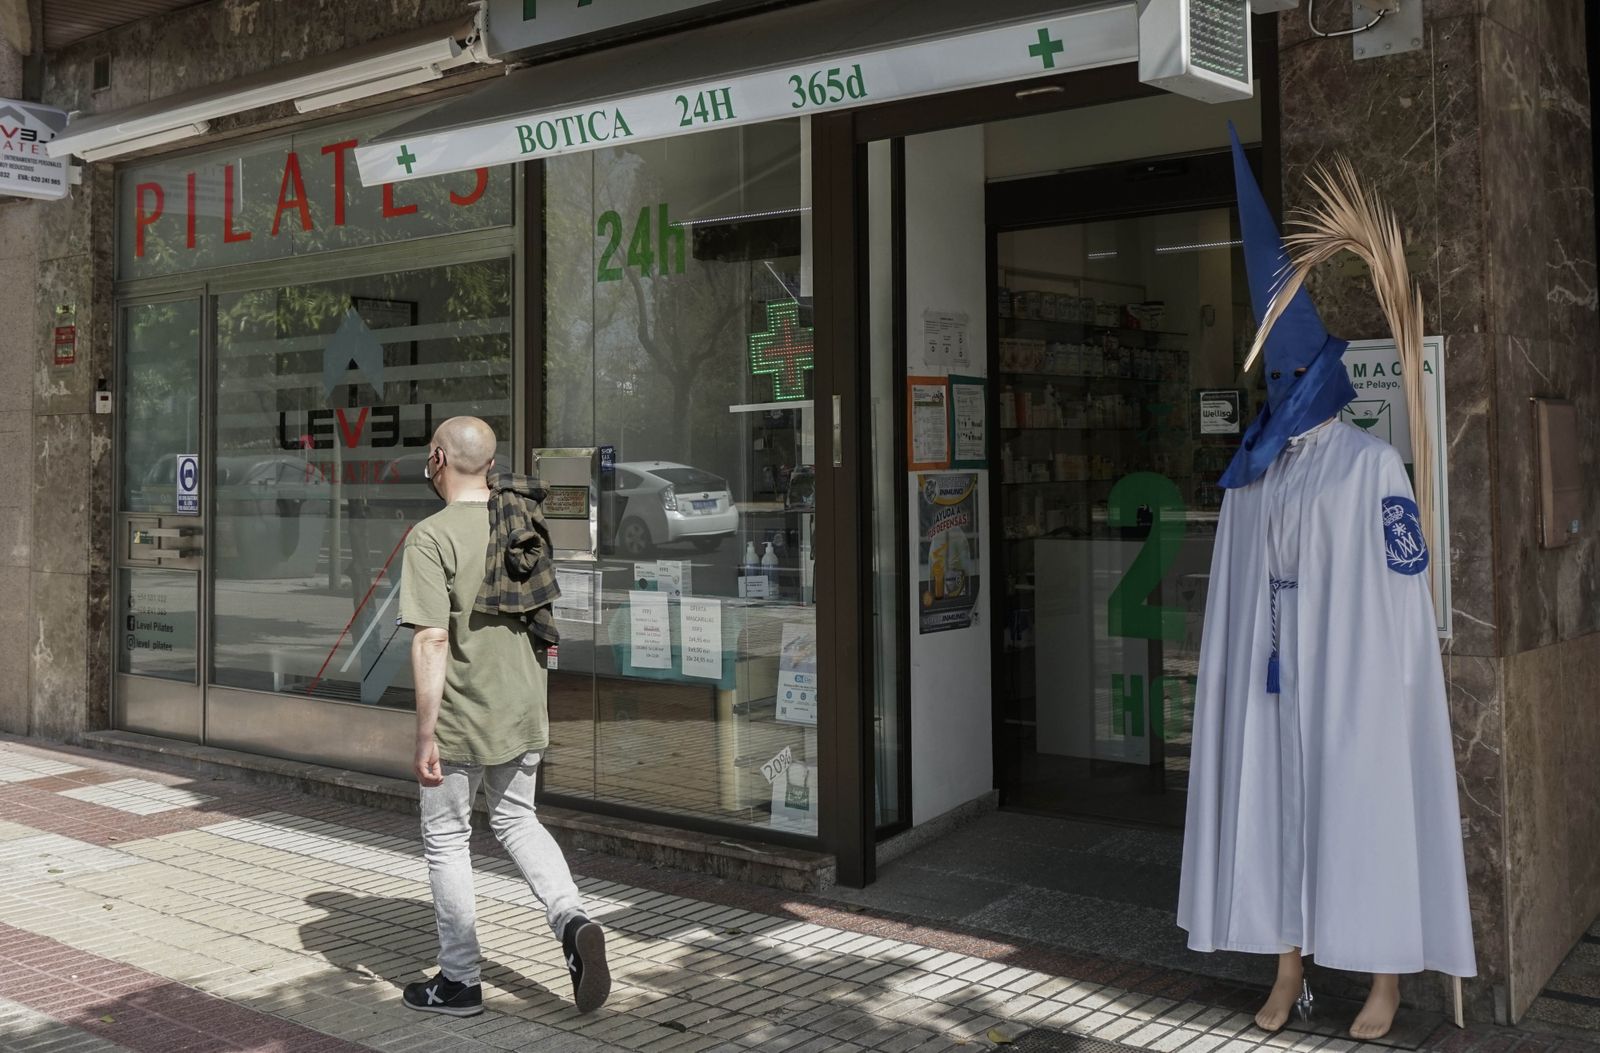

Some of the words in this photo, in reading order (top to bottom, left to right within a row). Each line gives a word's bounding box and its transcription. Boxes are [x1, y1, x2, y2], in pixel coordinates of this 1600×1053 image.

[515, 107, 634, 155] BOTICA
[675, 86, 737, 127] 24H
[788, 64, 868, 110] 365d
[3, 140, 49, 156] ATE
[597, 203, 686, 283] 24h
[1366, 380, 1401, 390] Pelayo,
[280, 403, 432, 451] LEVEL
[305, 459, 401, 484] PILATES
[1108, 471, 1187, 641] 2
[137, 620, 153, 631] Level
[153, 622, 174, 633] Pilates
[764, 749, 791, 780] 20%
